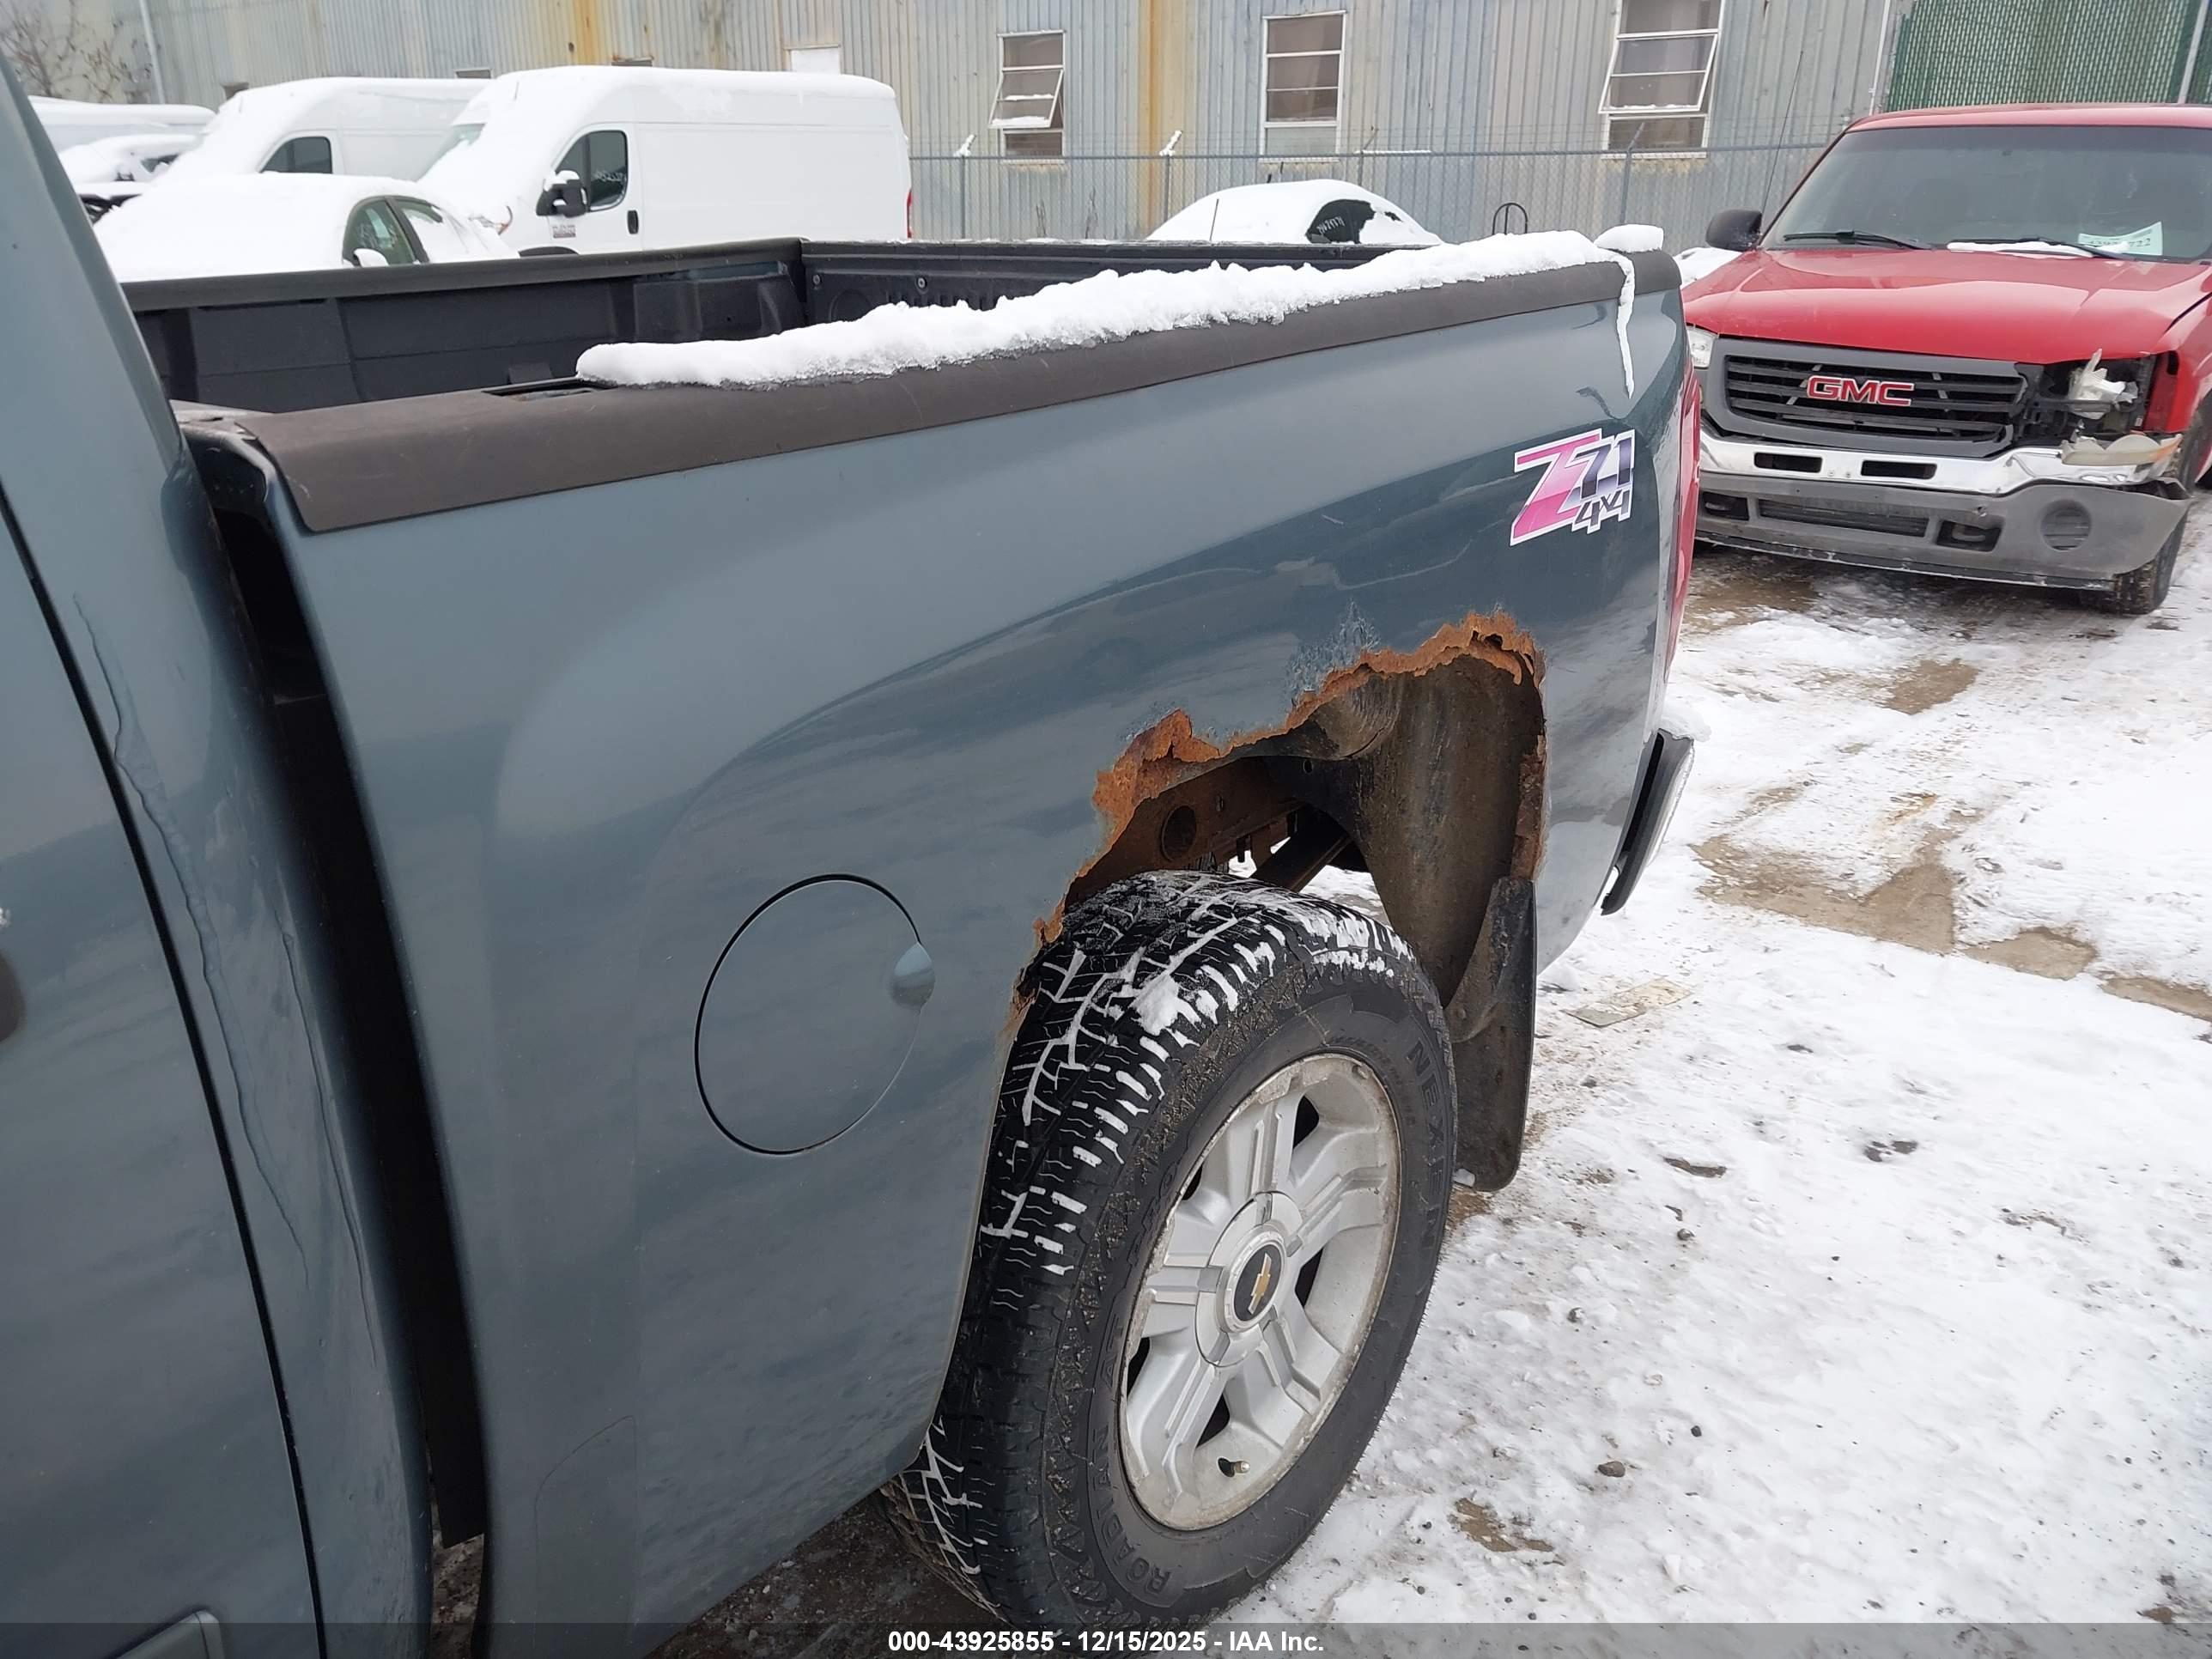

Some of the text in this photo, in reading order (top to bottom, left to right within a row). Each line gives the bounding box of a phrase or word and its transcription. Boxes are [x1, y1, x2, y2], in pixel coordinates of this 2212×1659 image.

[1807, 375, 1915, 407] GMC
[1510, 428, 1635, 546] Z71
[1405, 1036, 1445, 1250] NEXEN
[1091, 1425, 1172, 1599] ROADIAN
